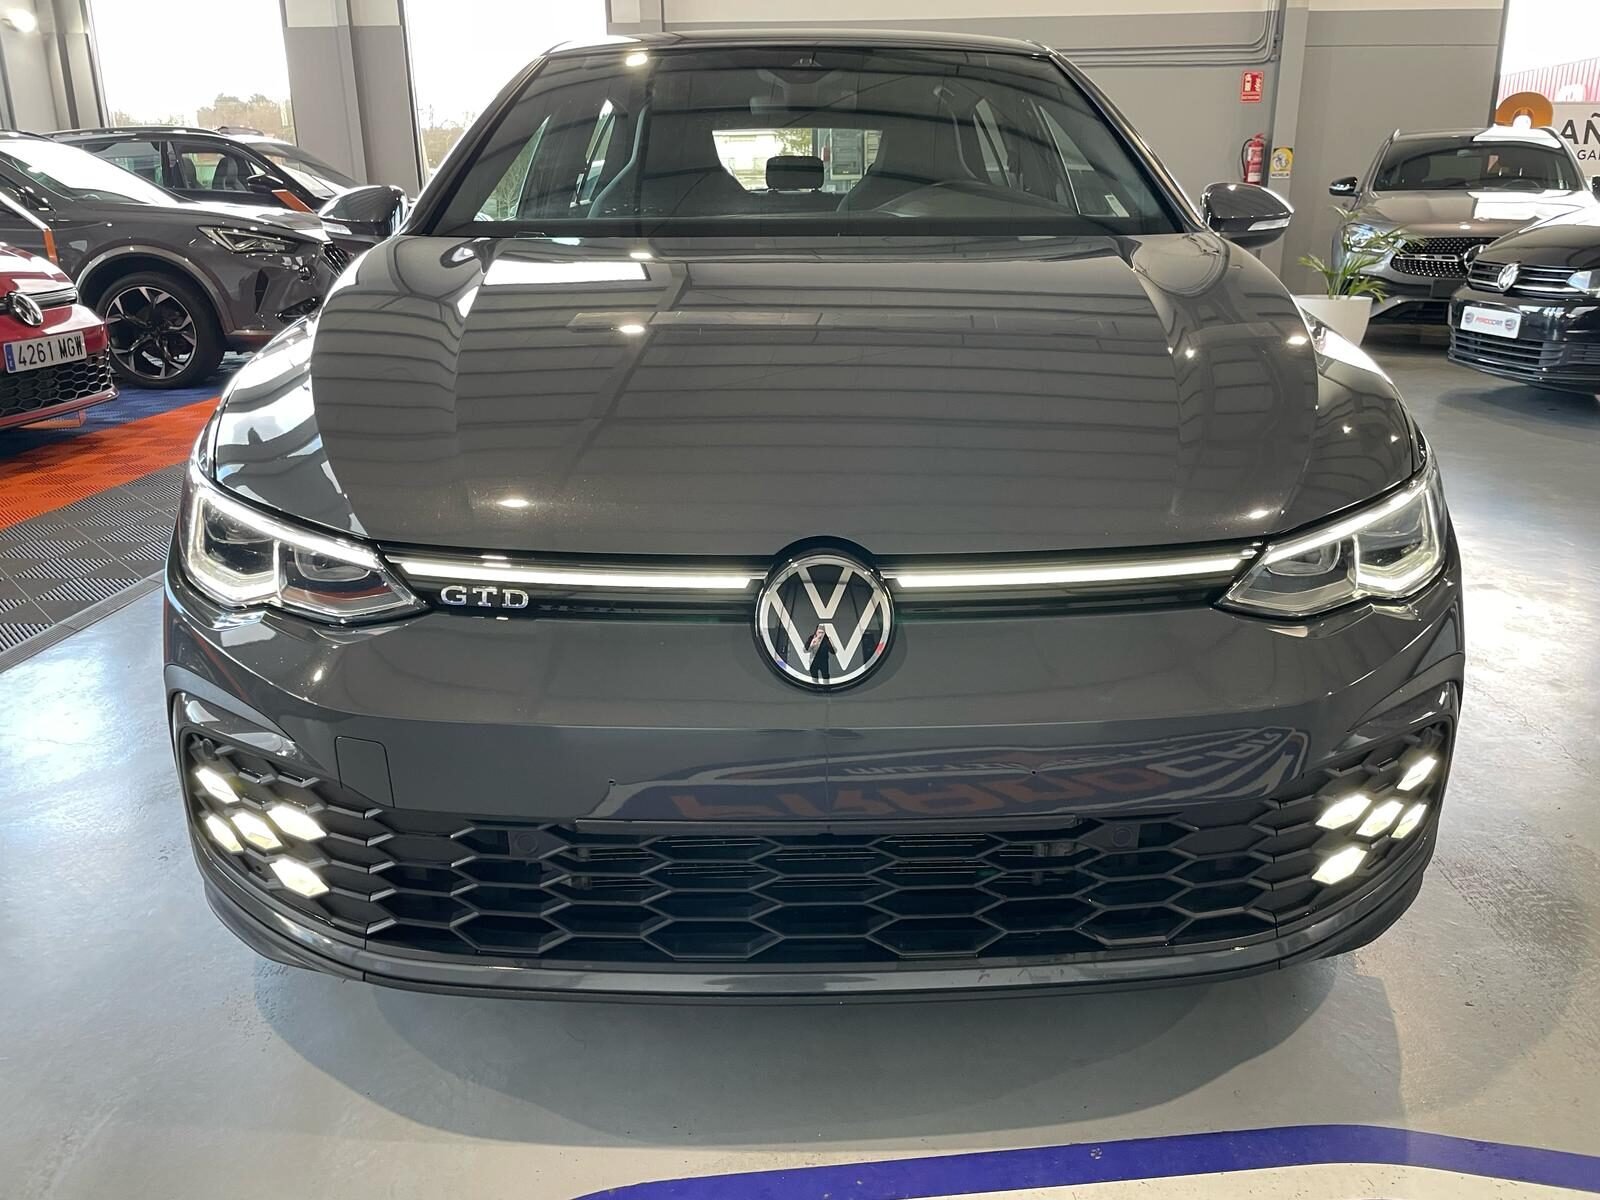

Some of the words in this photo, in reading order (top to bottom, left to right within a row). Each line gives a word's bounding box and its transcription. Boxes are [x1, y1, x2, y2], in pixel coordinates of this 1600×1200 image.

[1577, 149, 1600, 161] GA
[18, 341, 54, 367] 4261
[57, 335, 83, 360] MGW
[440, 585, 529, 609] GTD
